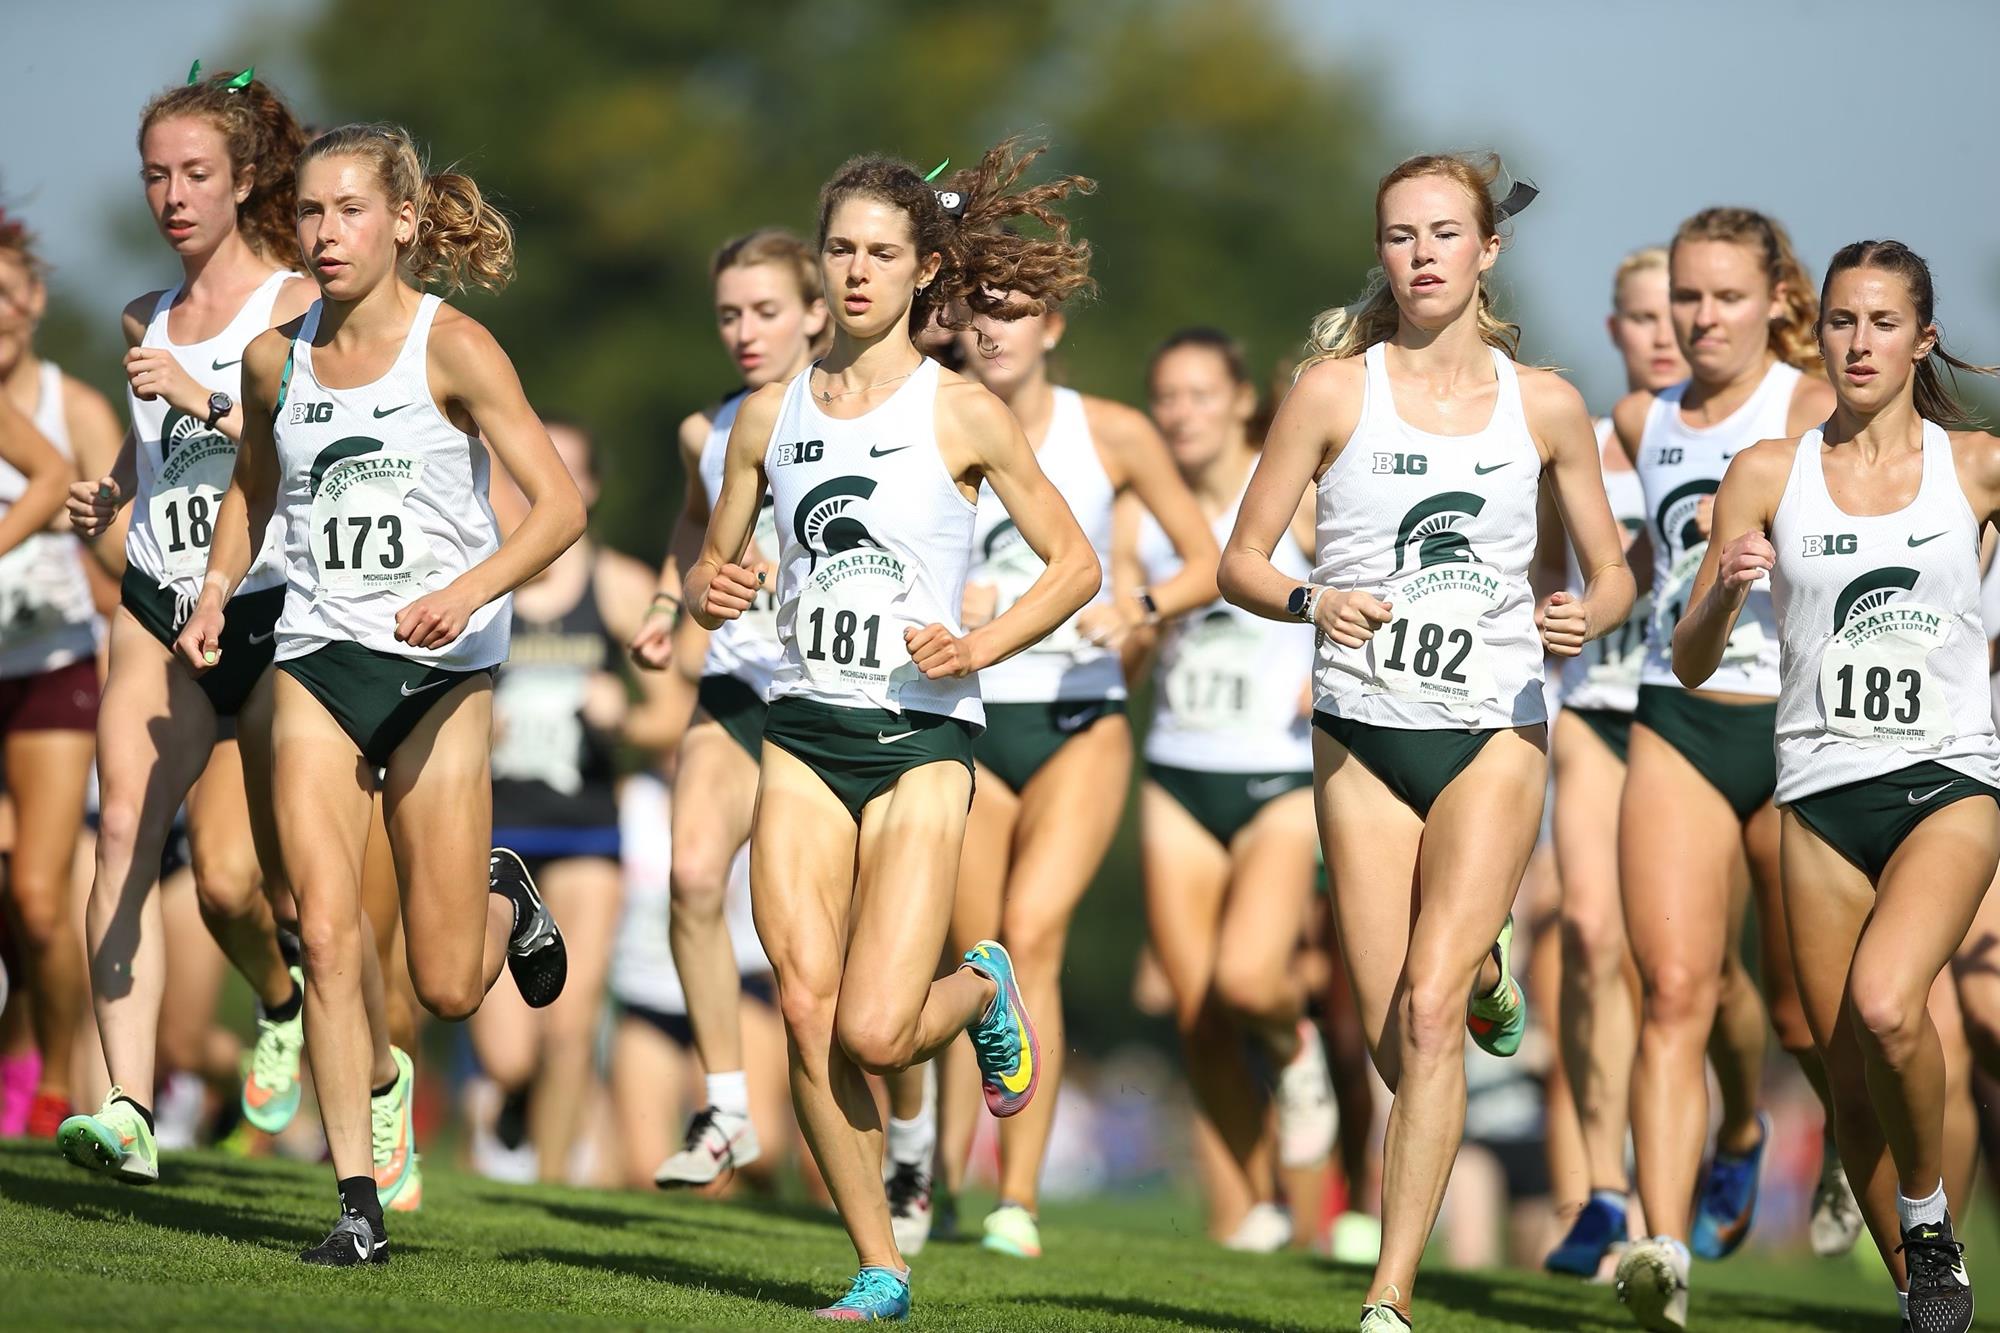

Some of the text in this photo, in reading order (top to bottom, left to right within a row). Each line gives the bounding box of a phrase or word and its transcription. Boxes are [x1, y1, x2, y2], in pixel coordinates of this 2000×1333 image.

[170, 447, 237, 486] INVITATIONA
[325, 457, 412, 496] SPARTAN
[332, 469, 414, 502] INVITATIONAL
[165, 493, 225, 553] 18
[323, 514, 404, 570] 173
[815, 554, 906, 585] SPARTAN
[821, 566, 906, 593] INVITATIONAL
[1401, 569, 1500, 596] SPARTAN
[1407, 582, 1497, 604] INVITATIONAL
[806, 606, 881, 669] 181
[1844, 609, 1942, 642] SPARTAN
[1850, 622, 1940, 649] INVITATIONAL
[1383, 617, 1474, 684] 182
[1834, 664, 1922, 724] 183
